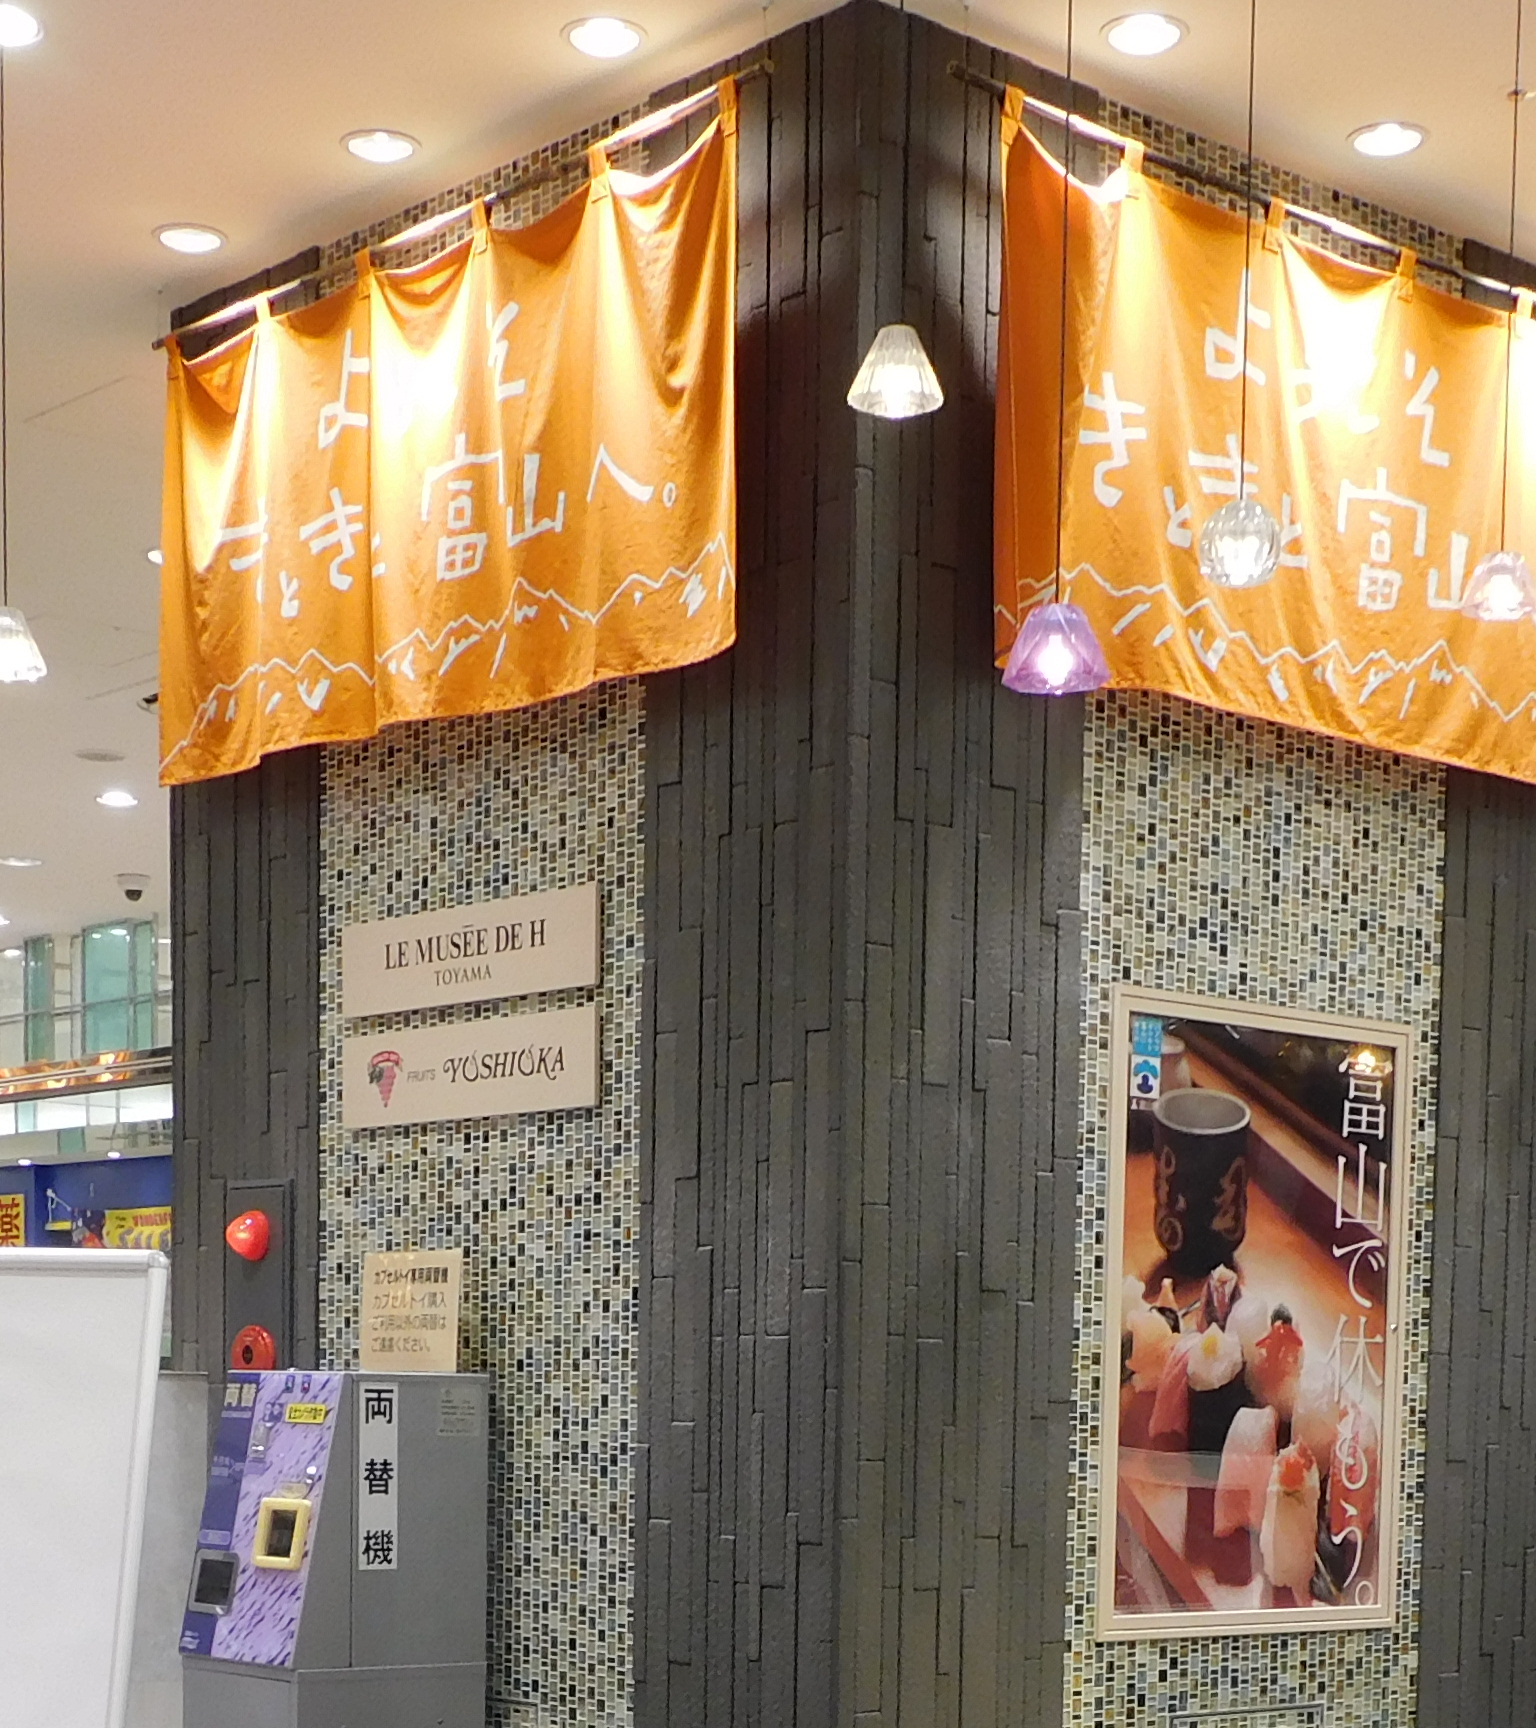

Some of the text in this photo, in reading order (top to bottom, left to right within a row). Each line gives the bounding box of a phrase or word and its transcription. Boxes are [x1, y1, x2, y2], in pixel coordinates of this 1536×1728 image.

[317, 301, 527, 449] よそ
[1203, 267, 1451, 467] よそ
[384, 941, 409, 970] LE
[494, 923, 523, 954] DE
[530, 919, 547, 948] H
[434, 964, 492, 987] TOYAMA
[407, 1044, 565, 1084] FRUITS YOSHIOKA
[1326, 1051, 1392, 1608] 富山で休もう。
[362, 1388, 395, 1566] 両替機
